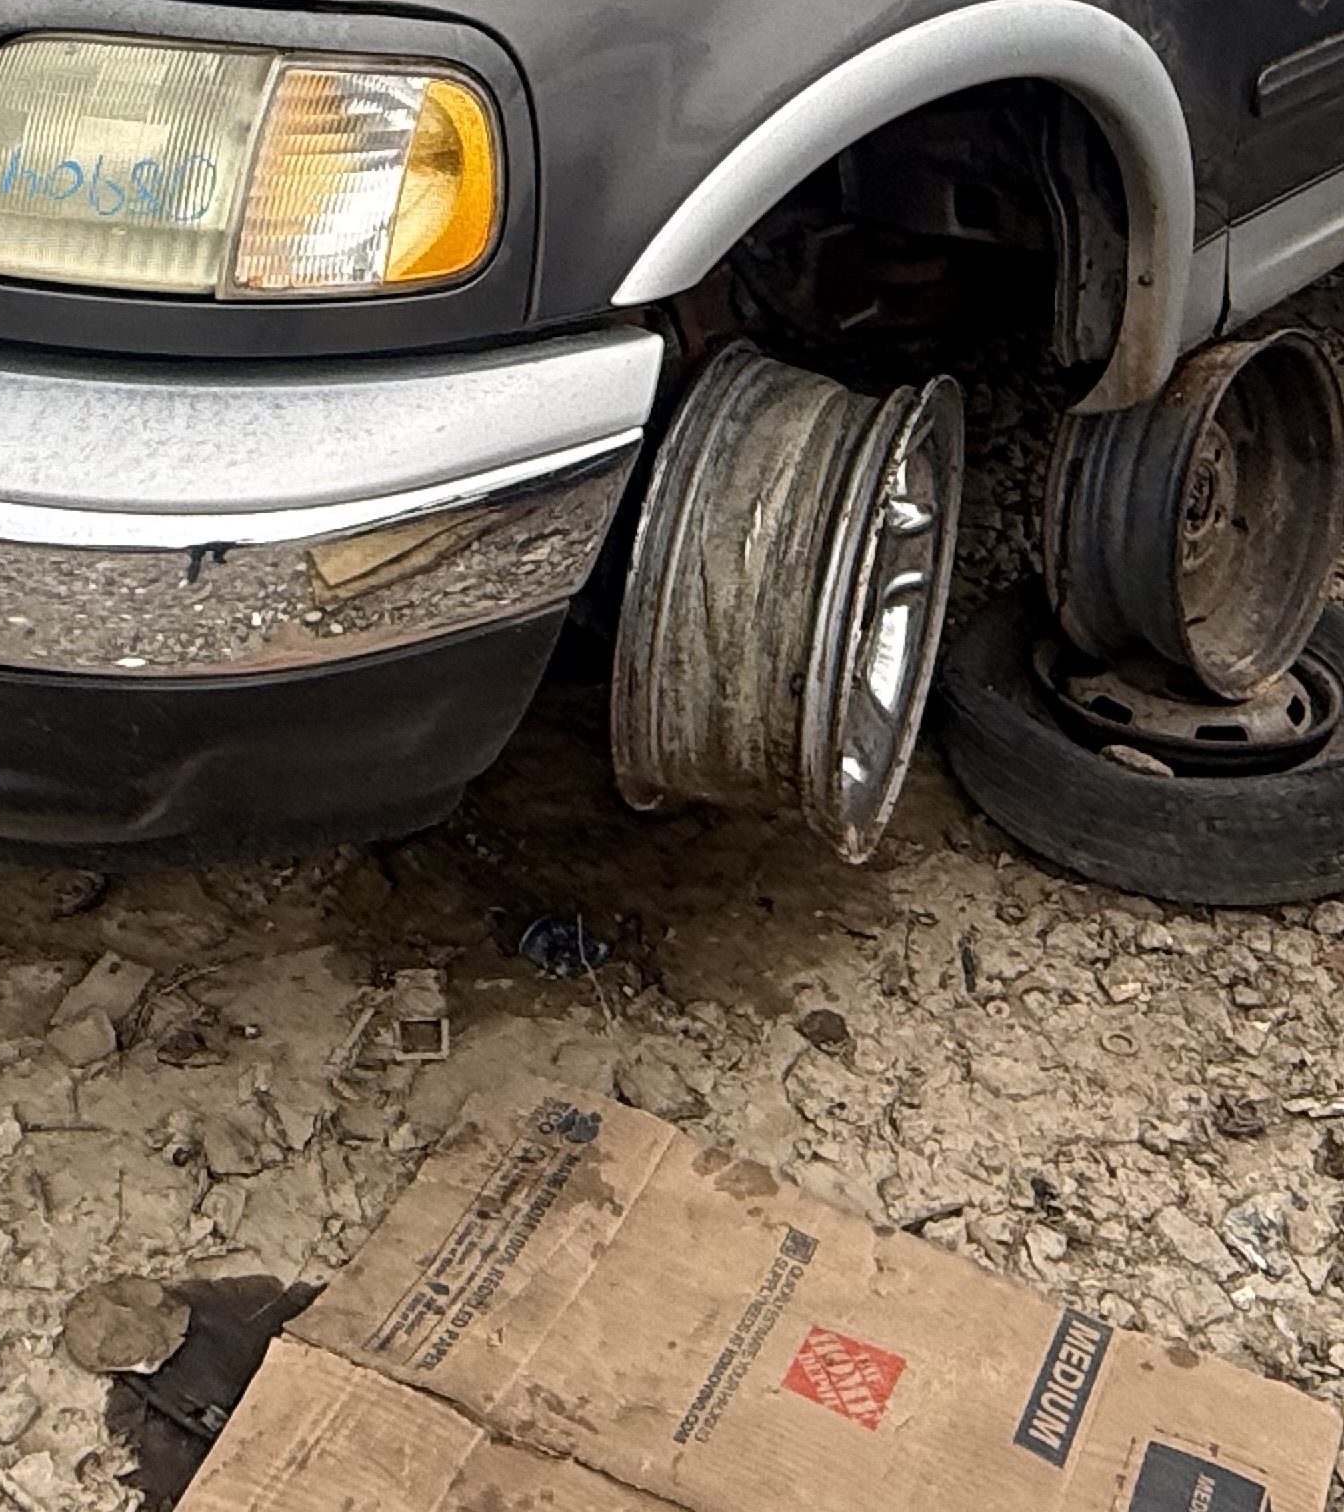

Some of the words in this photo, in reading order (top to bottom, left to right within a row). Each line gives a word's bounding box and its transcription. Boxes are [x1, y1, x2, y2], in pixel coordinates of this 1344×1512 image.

[520, 1189, 557, 1231] FROM
[452, 1266, 506, 1329] RECYCLED
[757, 1257, 789, 1304] SUPPLY
[735, 1297, 765, 1335] NEEDS
[798, 1348, 848, 1414] DEPOT
[811, 1333, 885, 1421] HOME
[1027, 1319, 1102, 1451] MEDIUM
